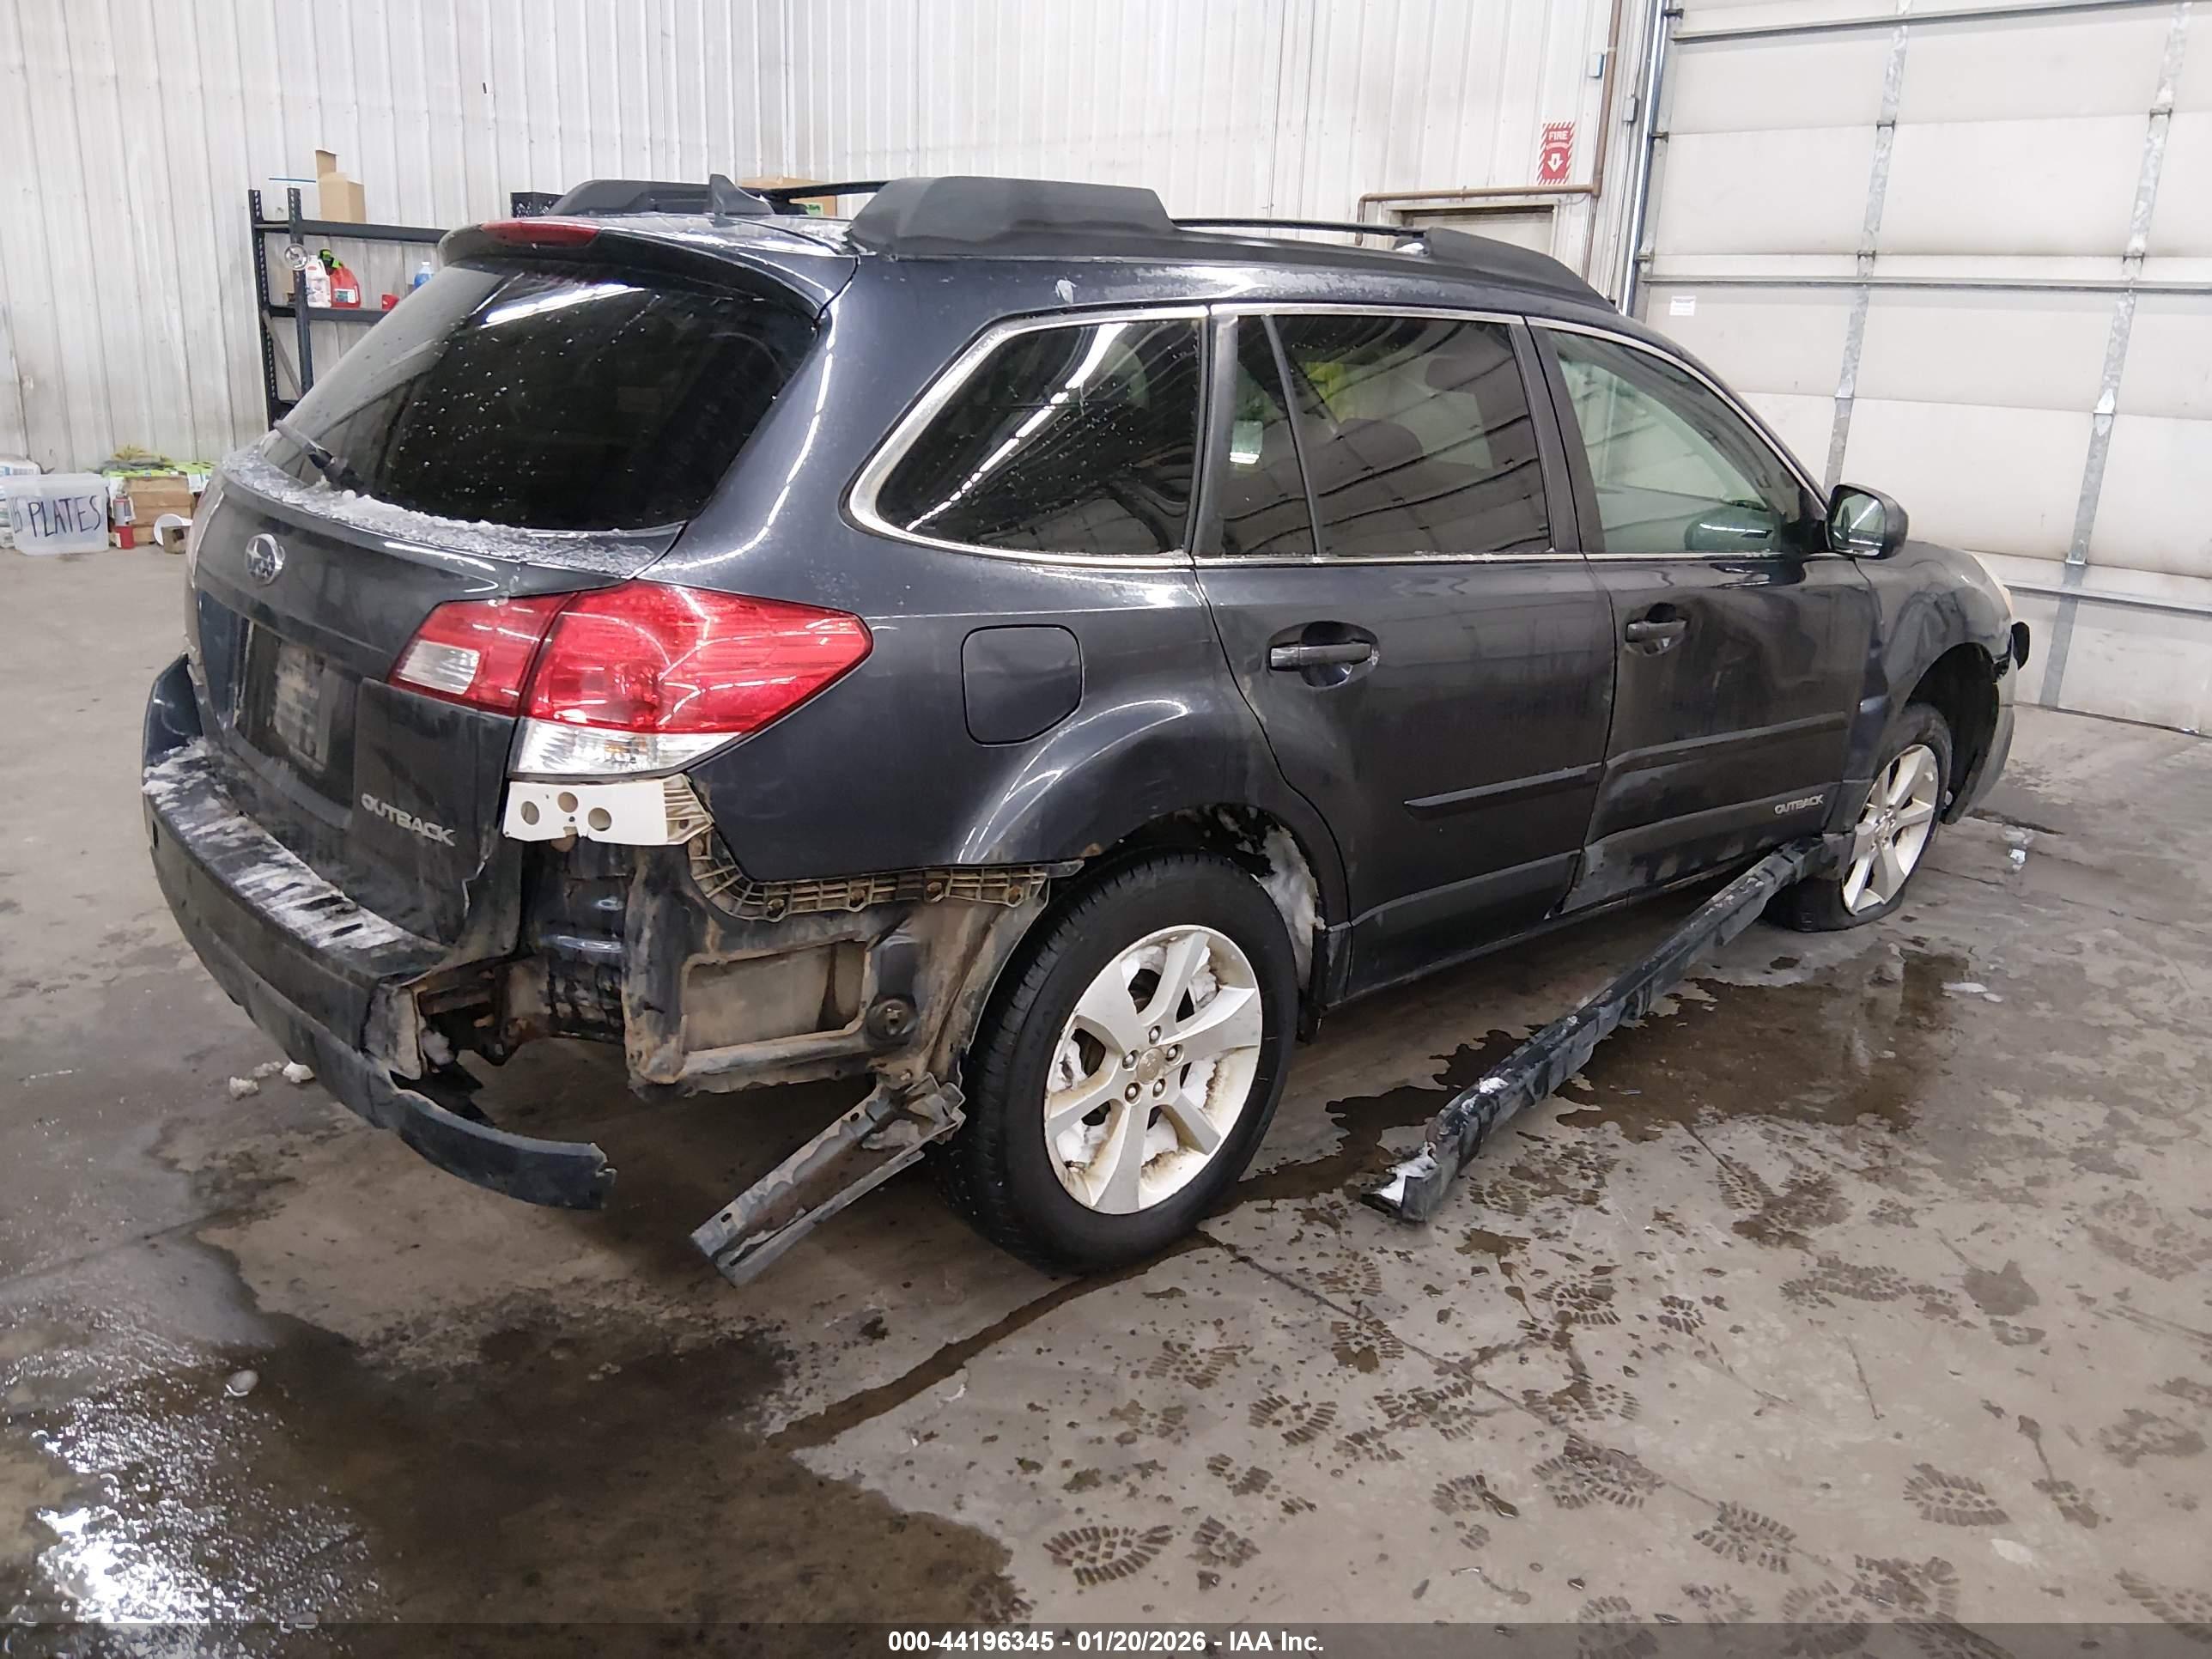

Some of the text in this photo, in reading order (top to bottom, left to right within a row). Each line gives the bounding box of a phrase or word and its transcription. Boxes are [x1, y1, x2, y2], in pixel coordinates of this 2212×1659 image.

[1548, 131, 1569, 141] FIRE
[27, 495, 101, 538] PLATES
[362, 793, 456, 847] OUTBACK
[1774, 794, 1824, 815] OUTBACK
